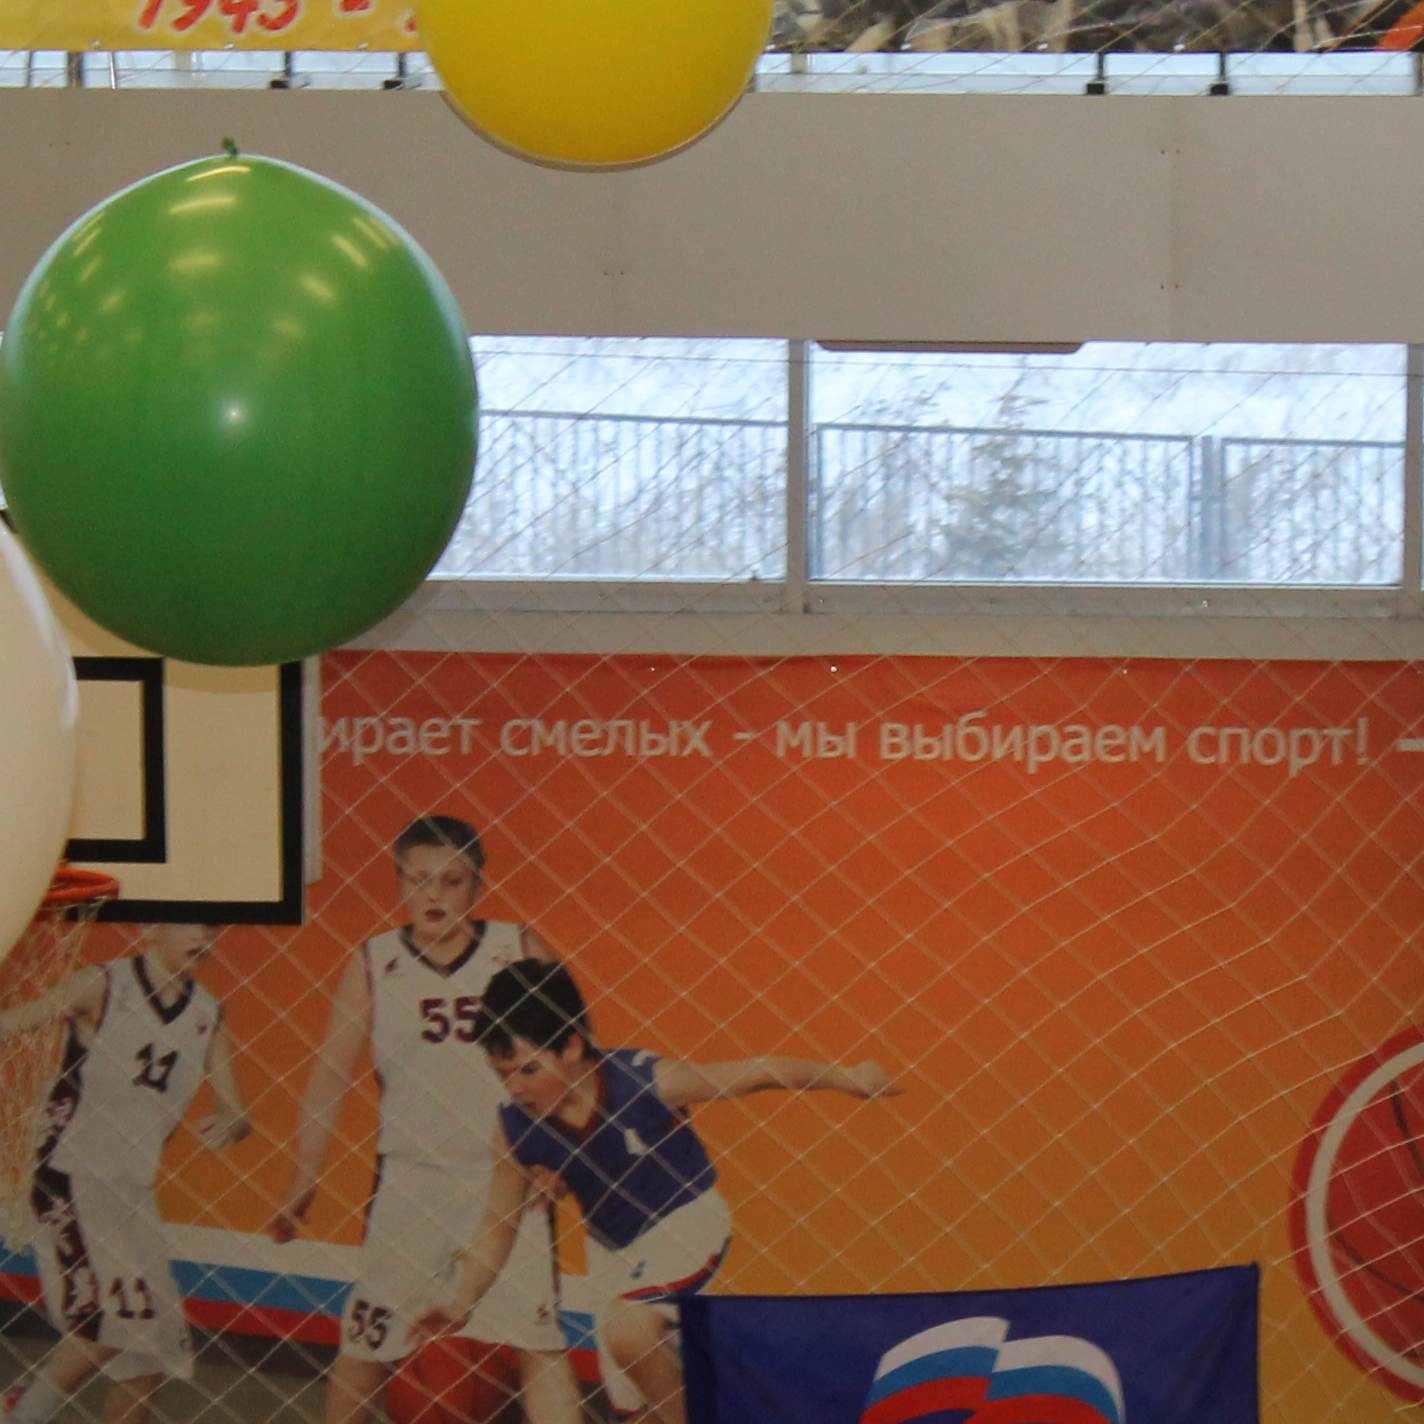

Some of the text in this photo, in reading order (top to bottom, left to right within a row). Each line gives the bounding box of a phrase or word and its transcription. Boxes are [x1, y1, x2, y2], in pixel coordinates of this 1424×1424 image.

[315, 716, 482, 767] ирает
[499, 718, 714, 758] смелых
[775, 720, 858, 759] мы
[879, 711, 1168, 775] выбираем
[1187, 717, 1370, 778] спорт!
[420, 997, 479, 1044] 55
[132, 1042, 179, 1093] 11
[109, 1277, 156, 1320] 11
[350, 1298, 393, 1351] 55
